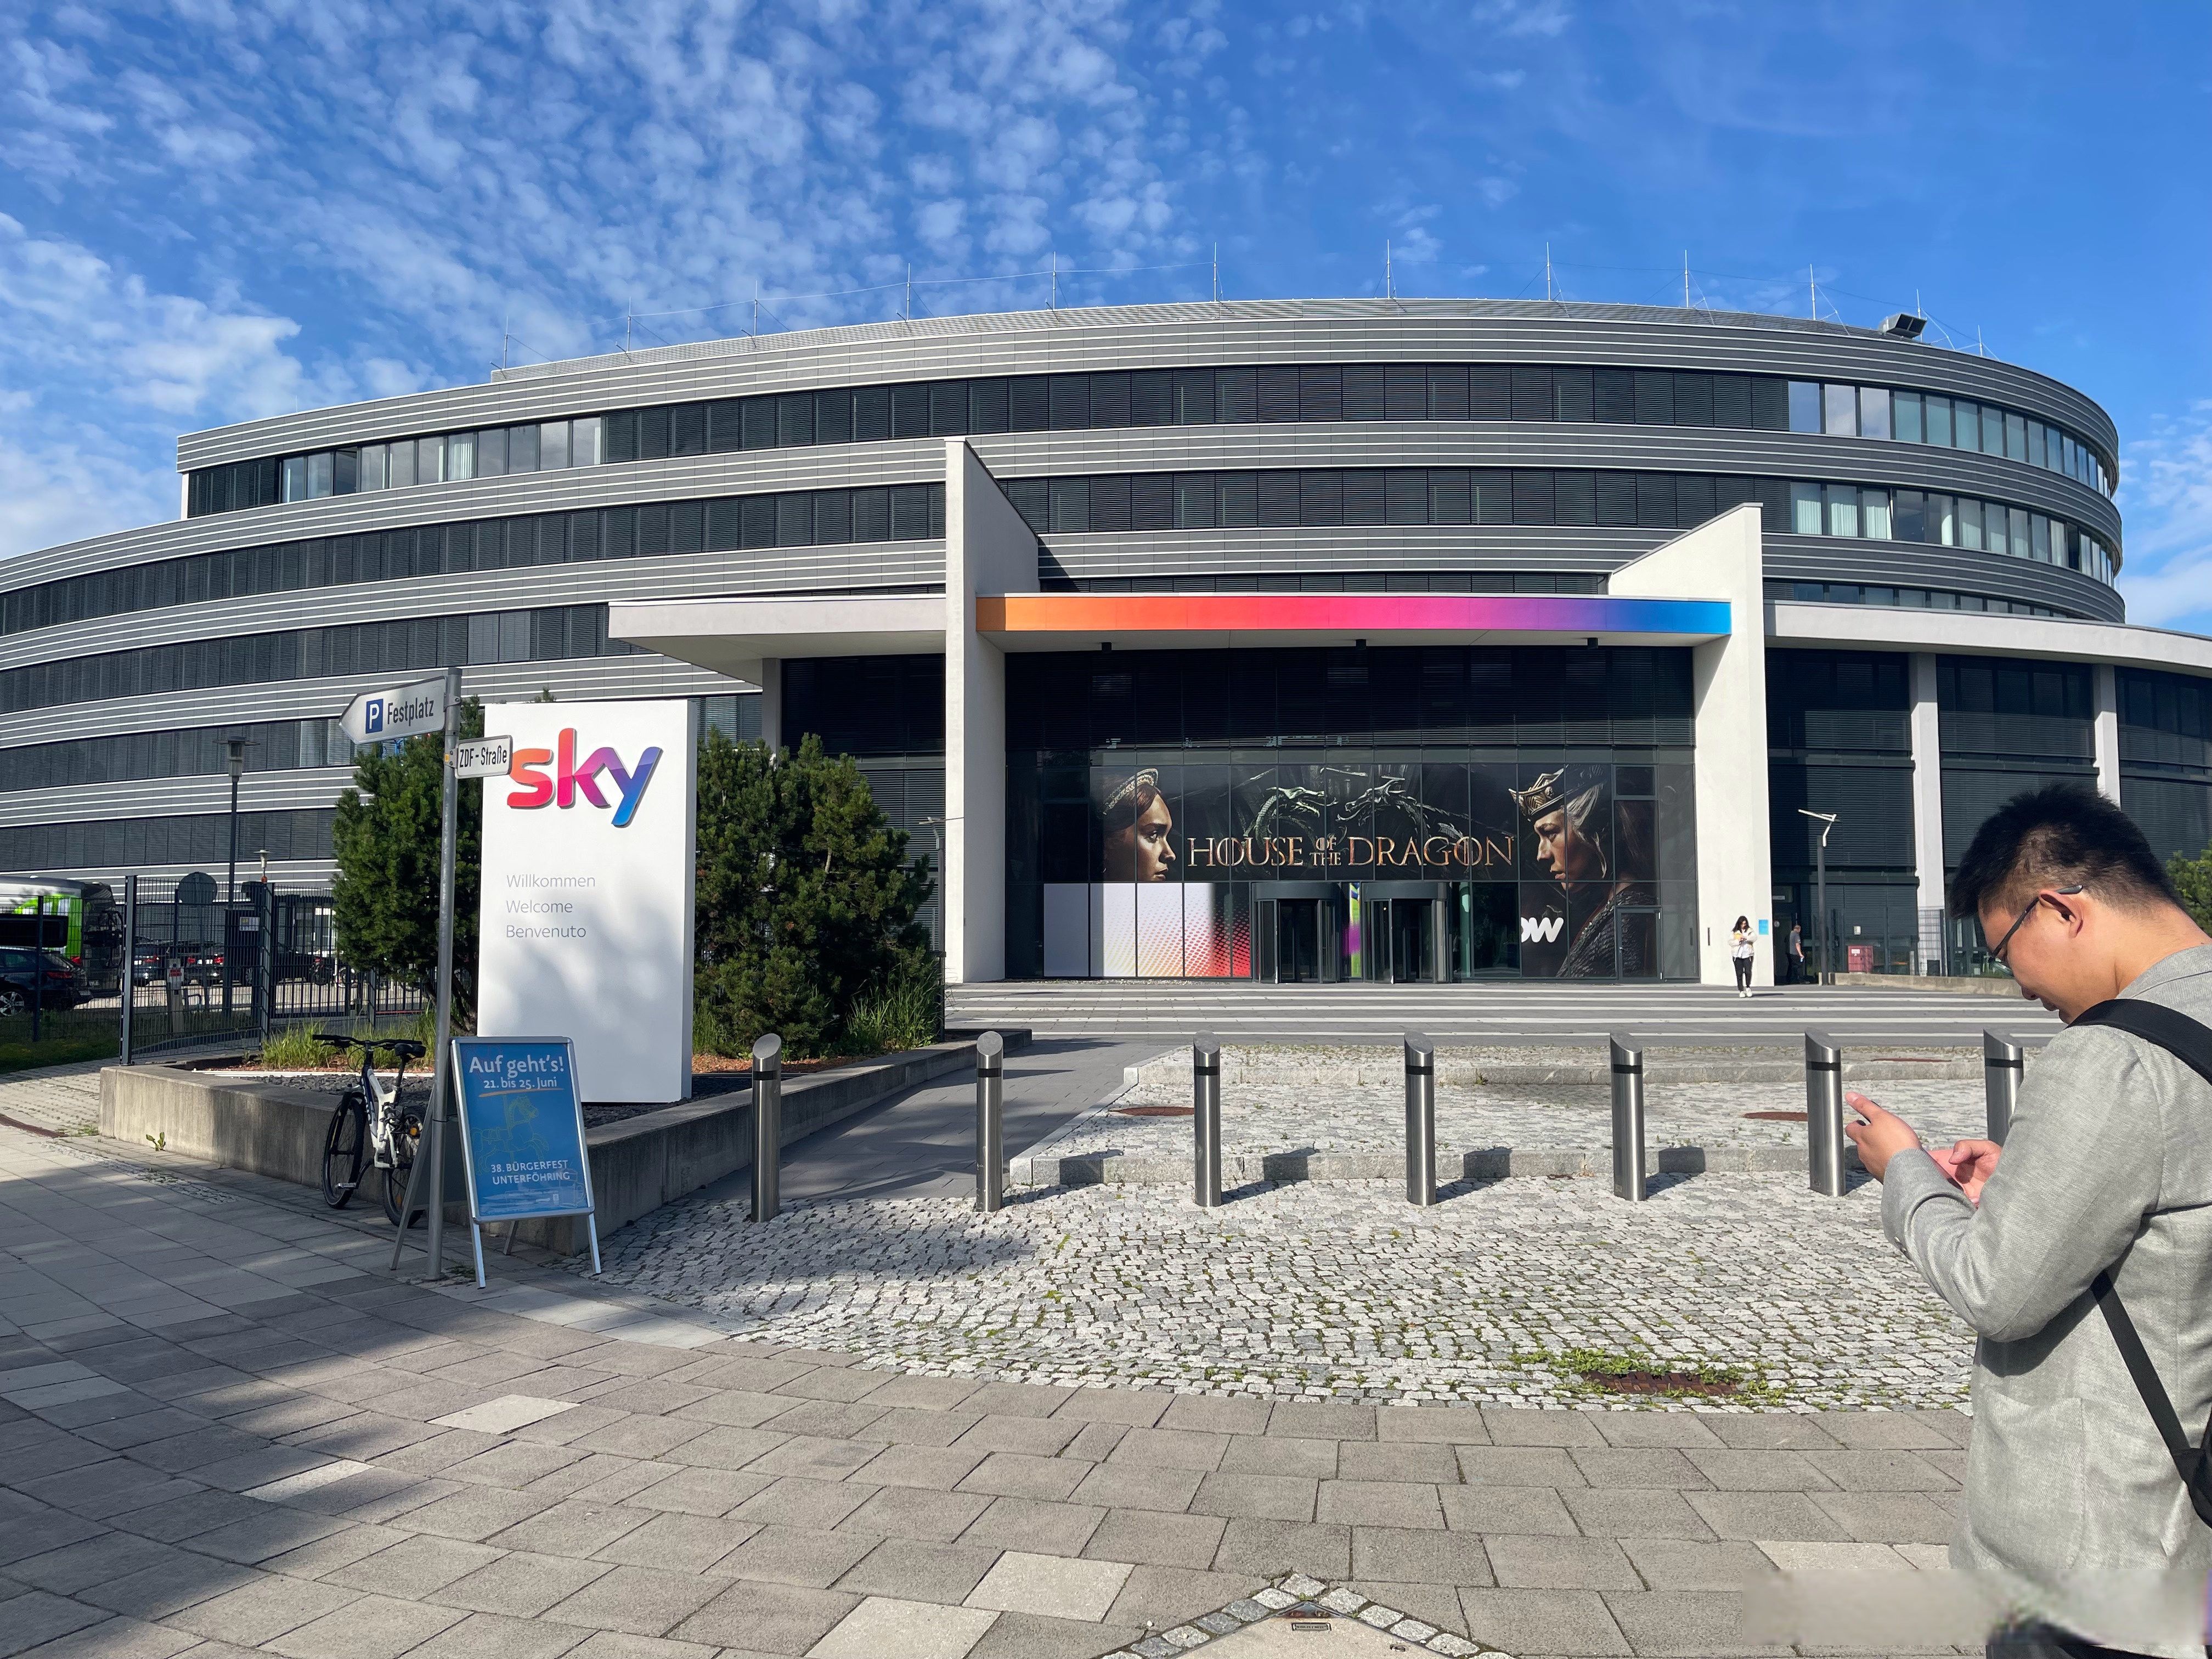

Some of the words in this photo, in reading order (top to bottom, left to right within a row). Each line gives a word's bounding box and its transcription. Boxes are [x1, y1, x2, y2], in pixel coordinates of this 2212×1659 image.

[369, 703, 380, 730] P
[387, 697, 434, 726] Festplatz
[507, 727, 664, 828] sky
[1316, 833, 1337, 851] OF
[1187, 837, 1304, 866] HOUSE
[1309, 852, 1341, 866] THE
[1347, 837, 1513, 866] DRAGON
[506, 874, 596, 888] Willkommen
[506, 899, 573, 913] Welcome
[506, 925, 586, 938] Benvenuto
[469, 1054, 504, 1073] Auf
[483, 1080, 499, 1089] 21.
[501, 1076, 516, 1088] bis
[519, 1079, 535, 1090] 25.
[537, 1076, 557, 1090] Juni
[490, 1164, 505, 1173] 38.
[506, 1160, 568, 1172] BÜRGERFEST
[492, 1171, 571, 1186] UNTERFÖHRING
